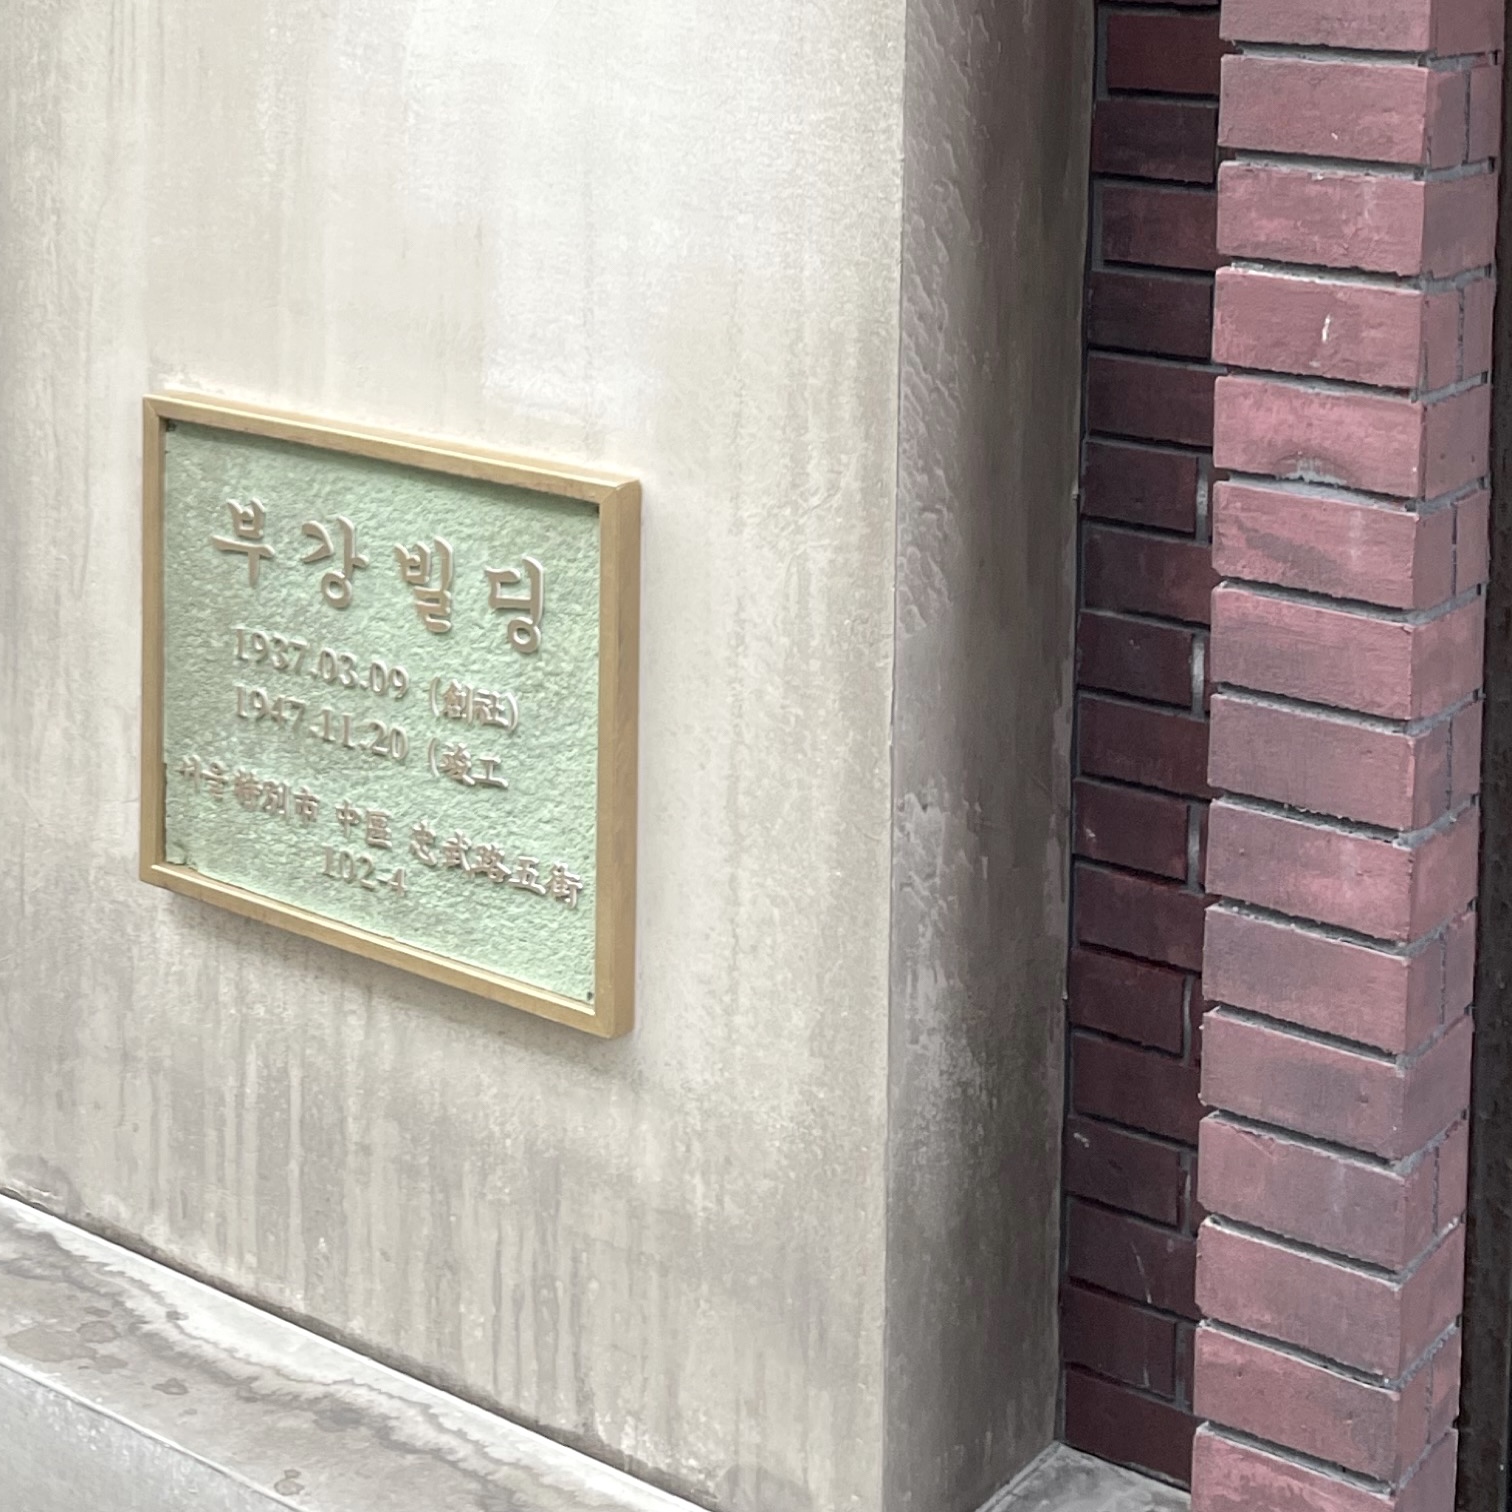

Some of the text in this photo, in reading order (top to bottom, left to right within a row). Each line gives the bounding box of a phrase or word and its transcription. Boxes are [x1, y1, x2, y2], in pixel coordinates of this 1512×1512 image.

[212, 496, 545, 655] 부강빌딩
[232, 624, 409, 700] 1937.03.09
[233, 683, 408, 761] 1947.11.20
[321, 843, 406, 897] 102-4
